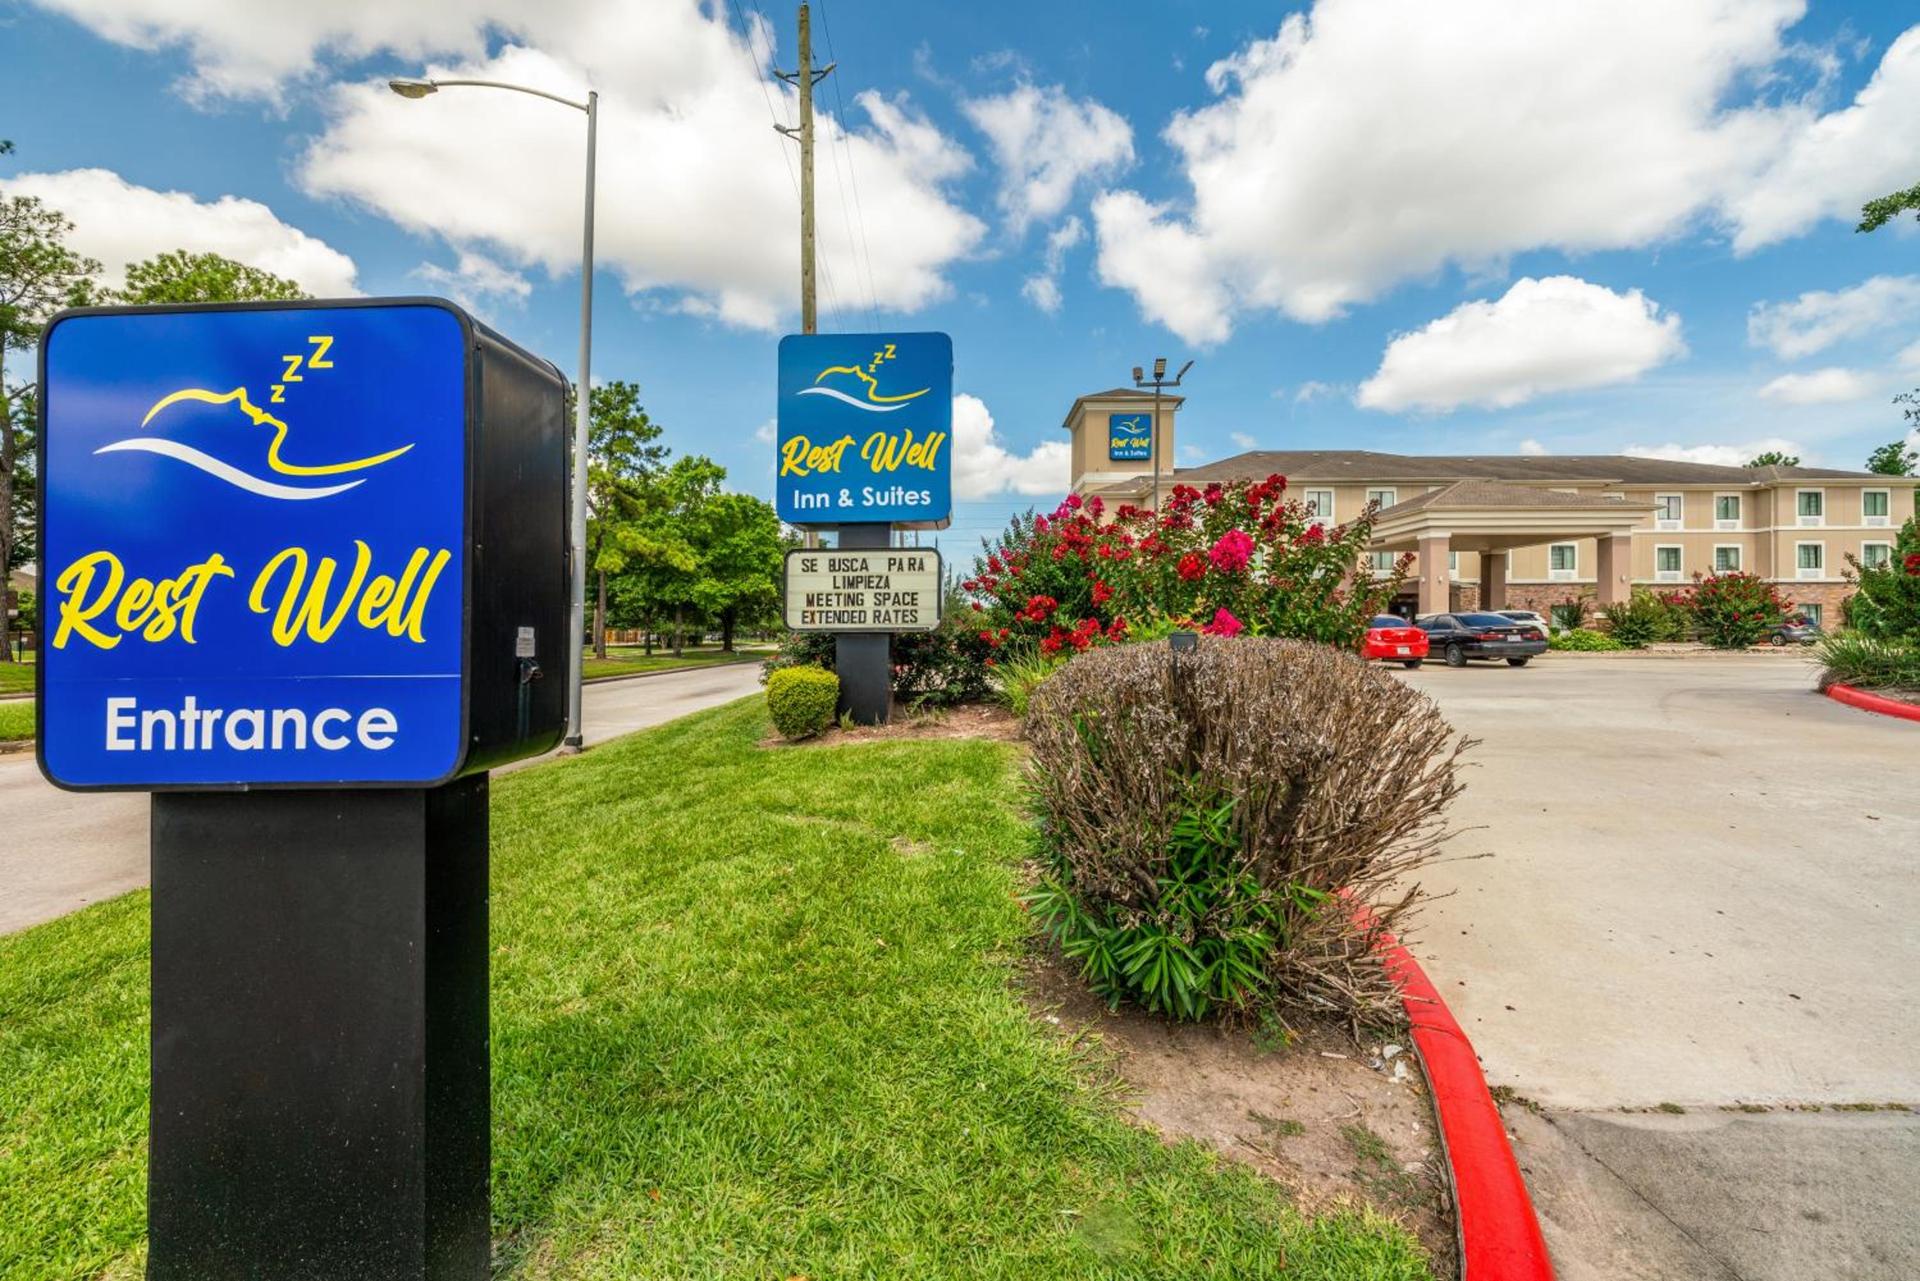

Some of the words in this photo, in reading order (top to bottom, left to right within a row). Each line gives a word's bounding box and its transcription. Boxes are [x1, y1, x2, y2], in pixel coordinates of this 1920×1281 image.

[780, 435, 856, 477] Rest
[861, 428, 946, 473] Well
[793, 490, 830, 509] Inn
[838, 488, 854, 507] &
[862, 486, 931, 506] Suites
[801, 558, 818, 573] SE
[828, 557, 869, 573] BUSCA
[887, 557, 925, 572] PARA
[833, 575, 890, 590] LIMPIEZA
[52, 550, 235, 650] Rest
[248, 540, 451, 648] Well
[806, 593, 864, 608] MEETING
[873, 592, 919, 607] SPACE
[801, 610, 867, 625] EXTENDED
[872, 609, 918, 624] RATES
[105, 695, 399, 752] Entrance
